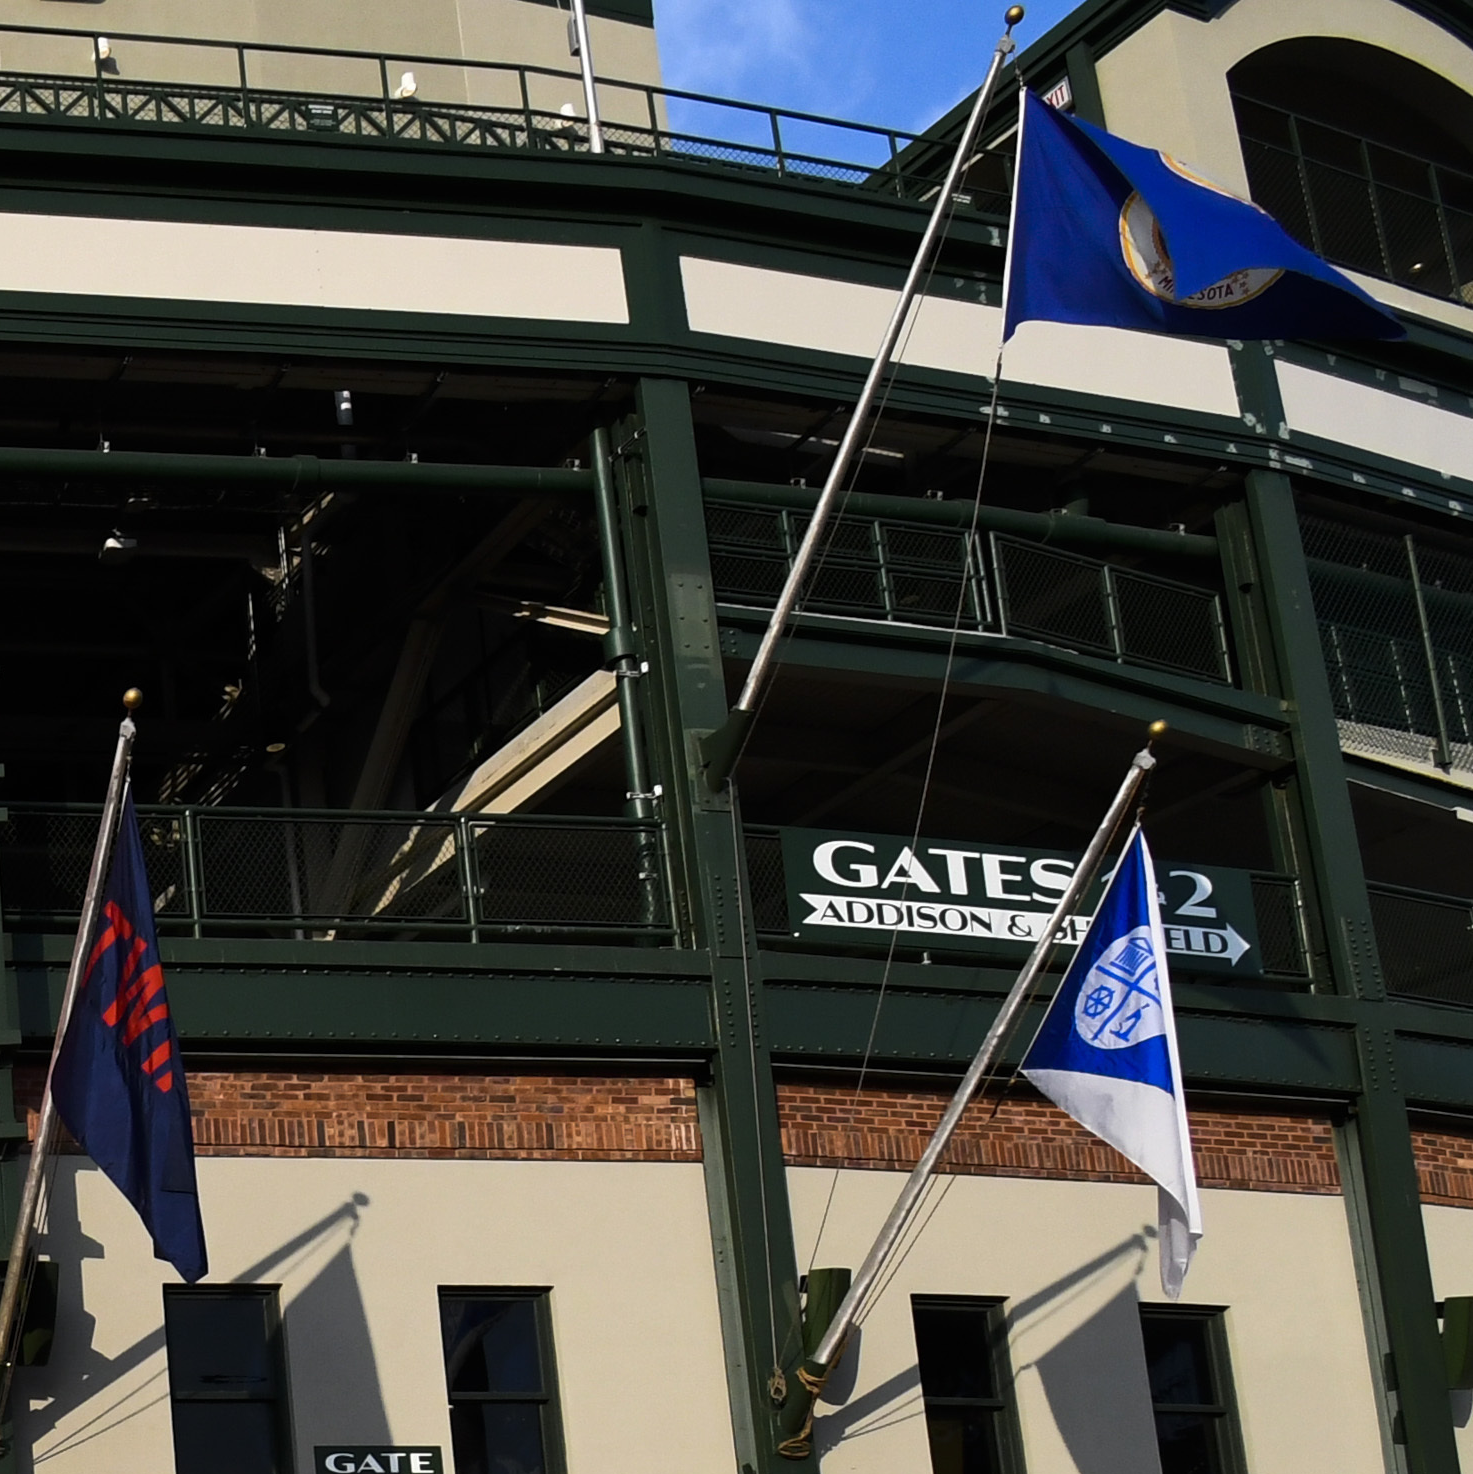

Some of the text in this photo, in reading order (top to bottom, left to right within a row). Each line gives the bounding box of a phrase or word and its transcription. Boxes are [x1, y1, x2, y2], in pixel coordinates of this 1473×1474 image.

[1046, 84, 1064, 107] XIT
[812, 840, 1217, 918] GATES 2
[819, 898, 993, 933] ADDISON
[1007, 915, 1033, 938] &
[325, 1453, 434, 1474] GATE
